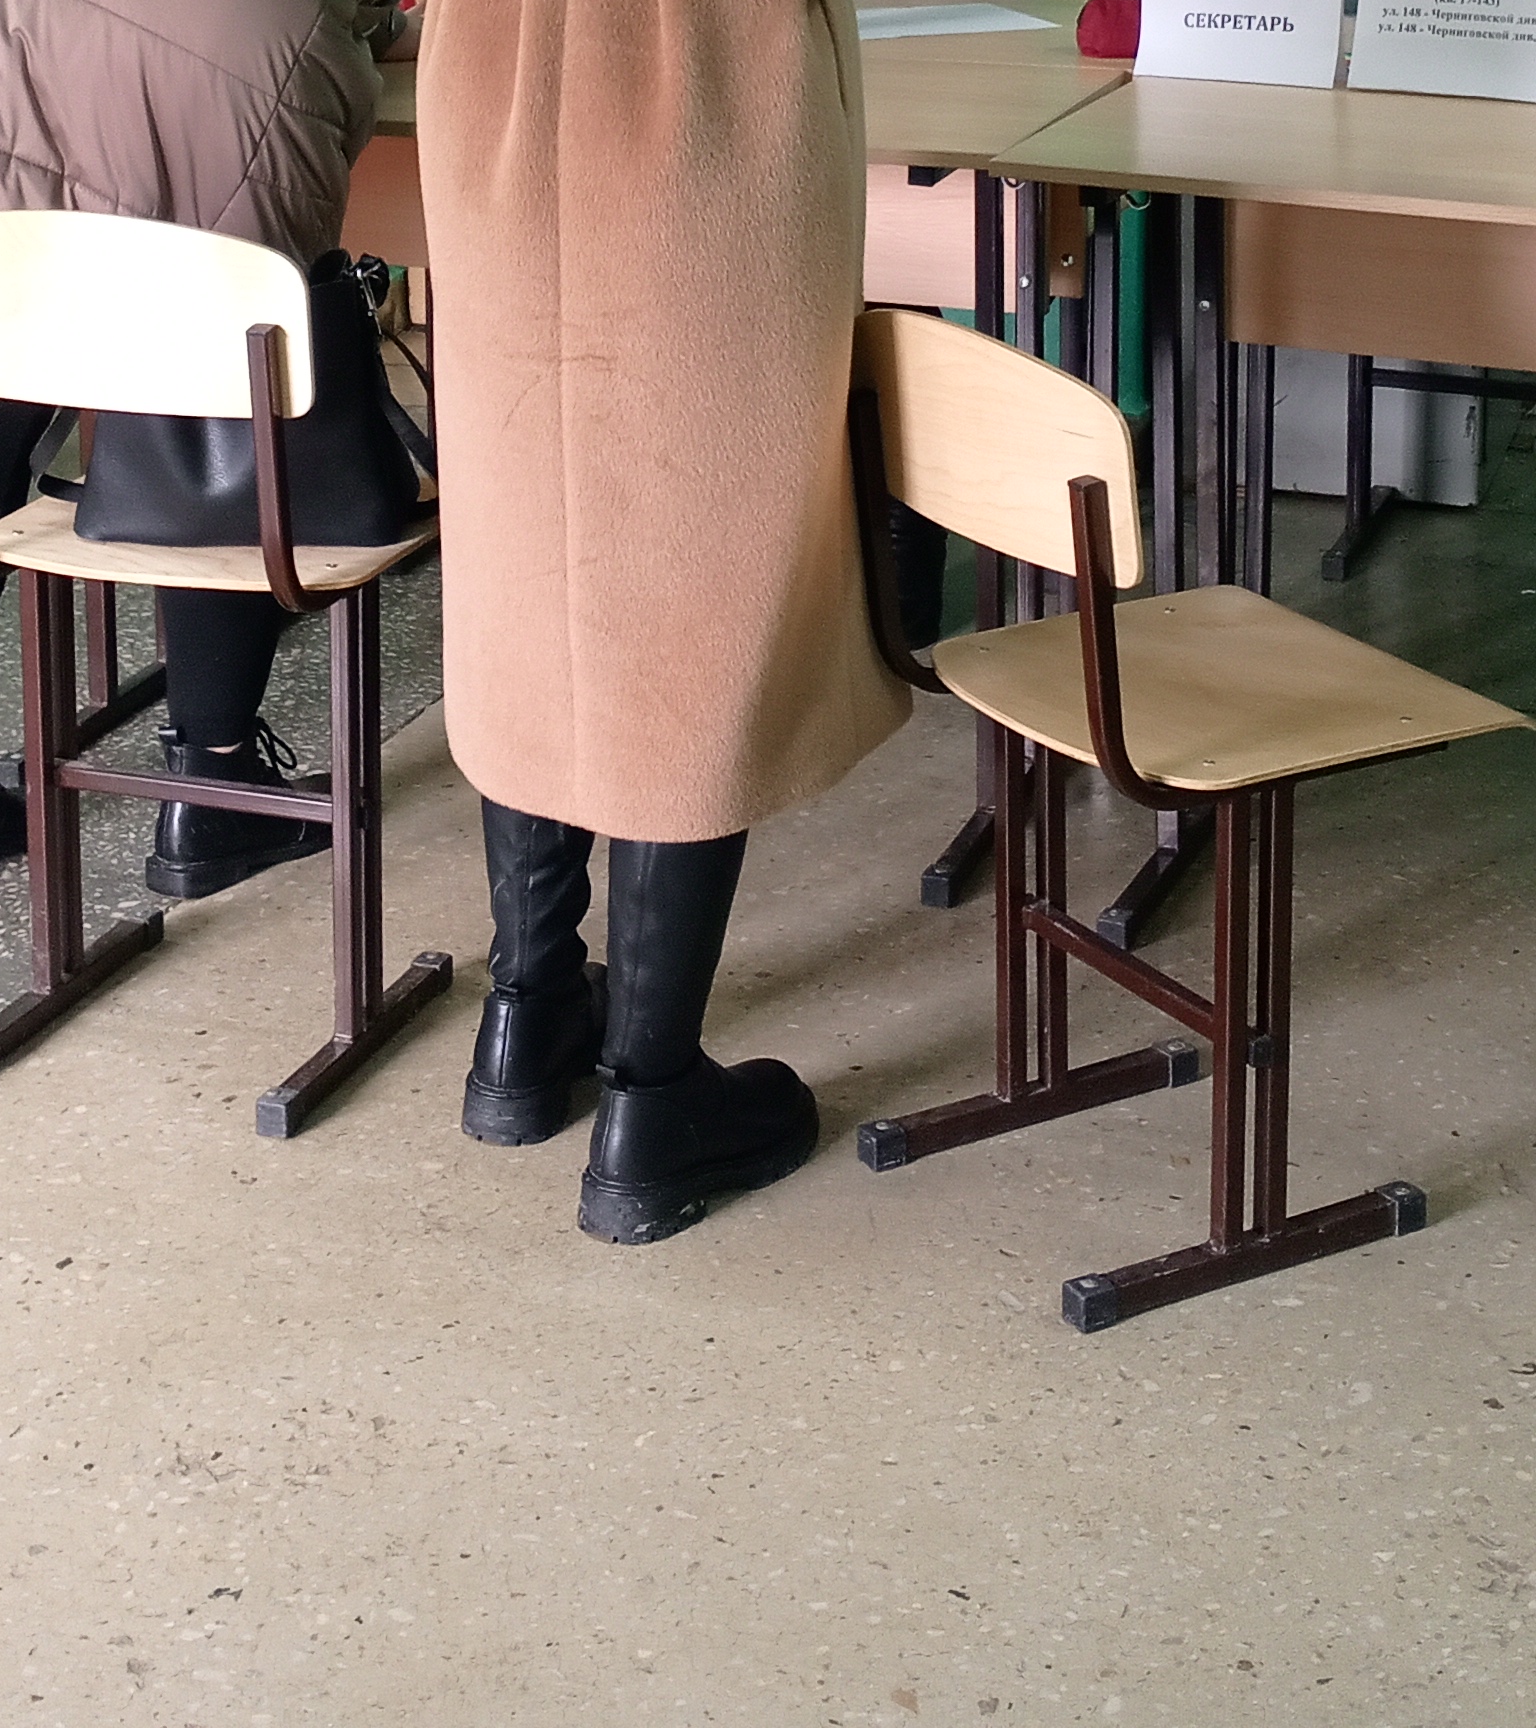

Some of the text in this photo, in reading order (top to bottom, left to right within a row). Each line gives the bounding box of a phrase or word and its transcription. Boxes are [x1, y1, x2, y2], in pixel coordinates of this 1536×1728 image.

[1184, 13, 1295, 32] СЕКРЕТАРЬ
[1383, 8, 1399, 17] ул.
[1403, 7, 1421, 17] 148
[1432, 9, 1514, 24] Черниговской
[1378, 24, 1395, 33] ул.
[1398, 23, 1417, 33] 148
[1427, 25, 1509, 40] Черниговской
[1512, 33, 1536, 42] див.
